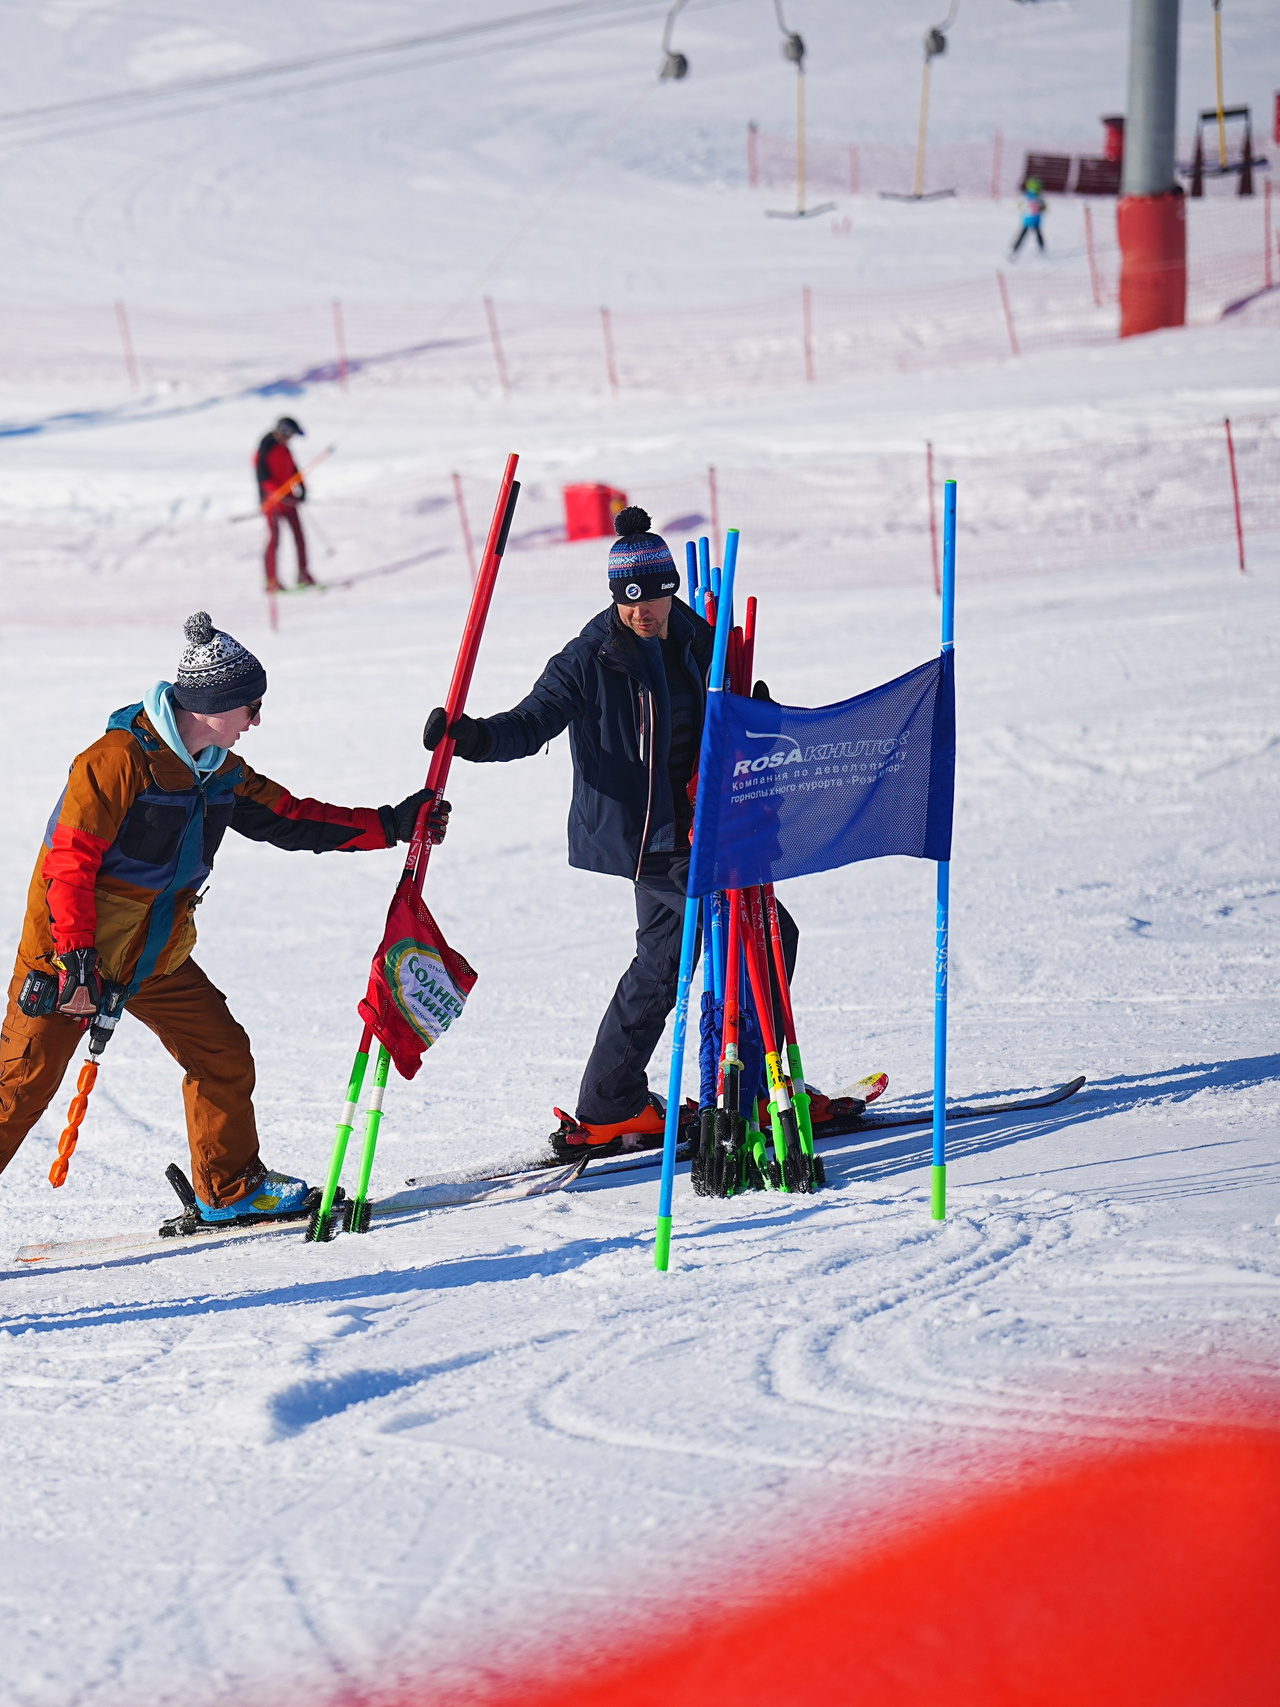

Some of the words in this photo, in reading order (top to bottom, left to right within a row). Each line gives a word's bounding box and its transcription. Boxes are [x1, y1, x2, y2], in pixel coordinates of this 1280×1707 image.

[732, 772, 788, 792] Компания
[794, 769, 808, 778] по
[798, 778, 843, 792] курорта
